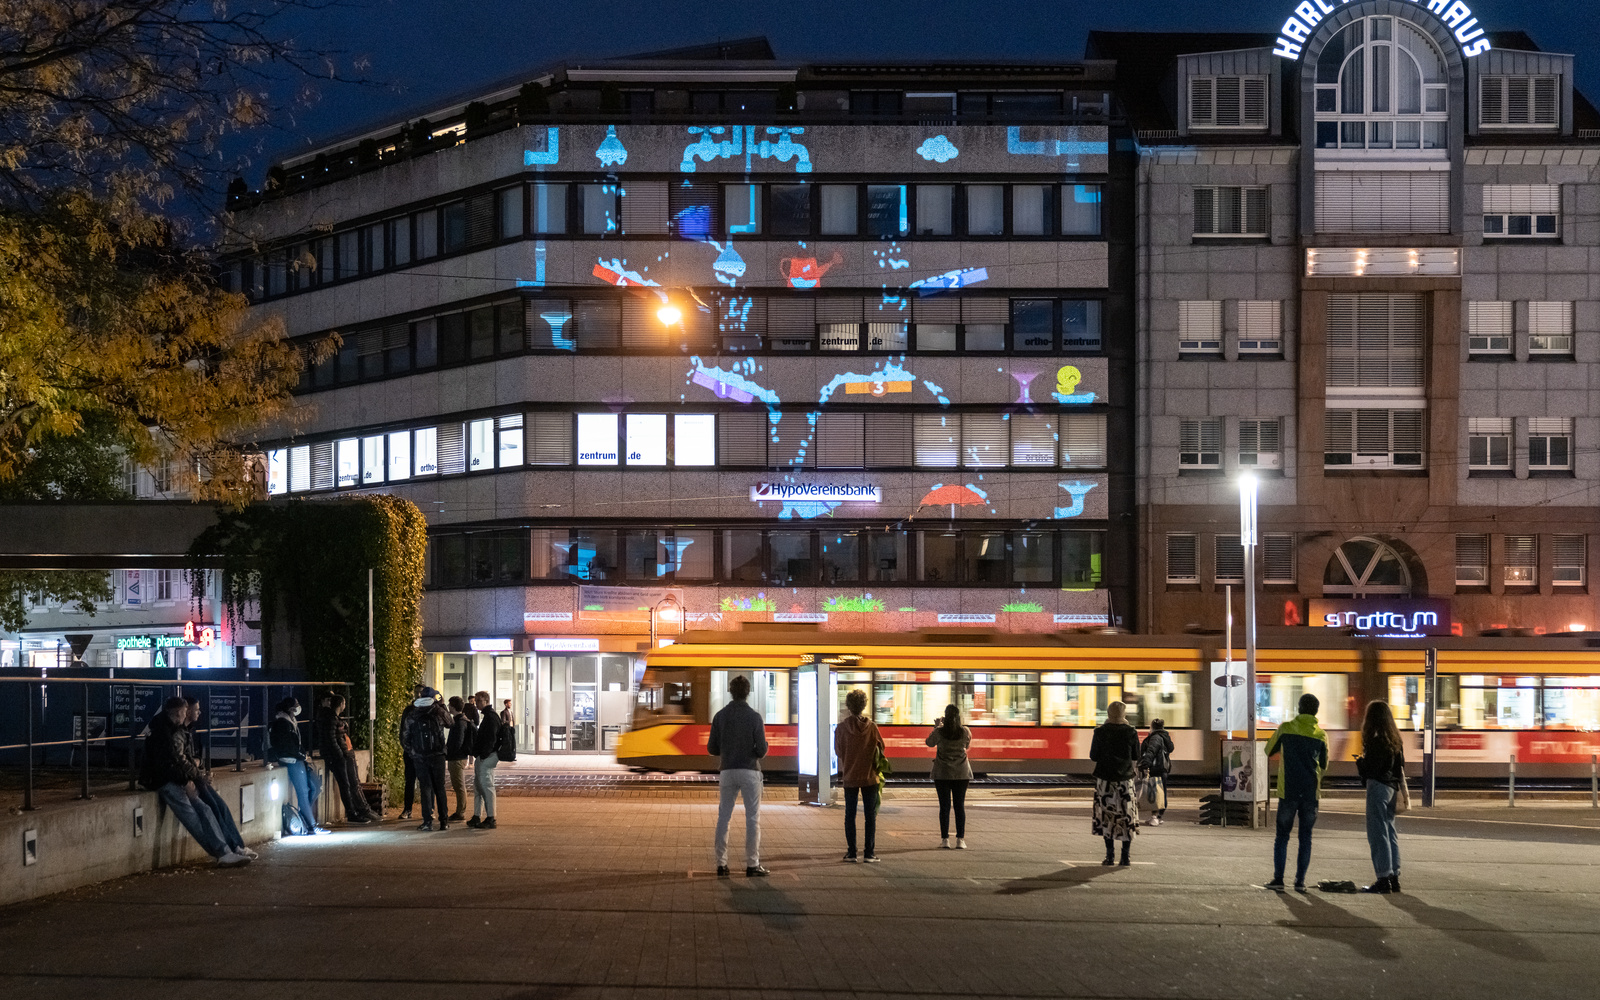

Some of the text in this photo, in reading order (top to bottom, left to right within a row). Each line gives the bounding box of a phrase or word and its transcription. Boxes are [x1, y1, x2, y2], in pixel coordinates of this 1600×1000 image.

[949, 275, 960, 288] 2
[821, 337, 858, 345] zentrum
[869, 337, 883, 345] .de
[1024, 337, 1100, 346] ortho- zentrum
[720, 382, 726, 395] 1
[873, 380, 884, 394] 3
[579, 451, 641, 460] zentrum .de
[420, 463, 437, 472] ortho-
[771, 483, 876, 498] HypoVereinsbank
[117, 636, 151, 650] apotheke
